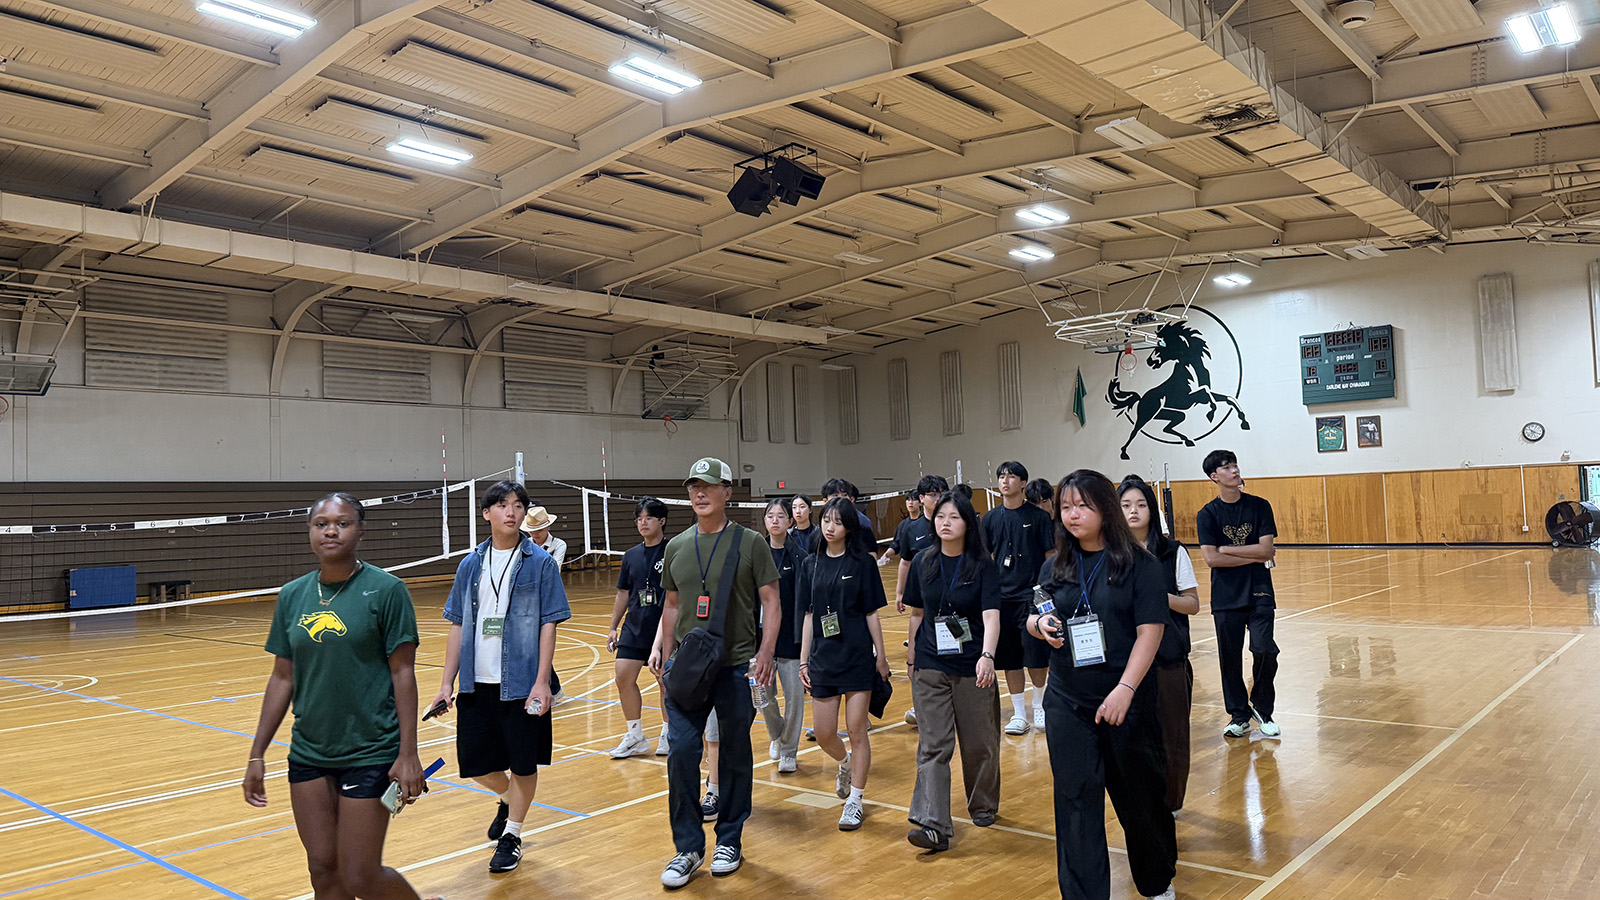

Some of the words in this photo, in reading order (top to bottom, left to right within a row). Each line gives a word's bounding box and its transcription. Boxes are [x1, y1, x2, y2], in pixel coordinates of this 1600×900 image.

[1336, 353, 1354, 362] period
[50, 525, 57, 533] 5
[80, 524, 87, 532] 5
[110, 523, 117, 531] 5
[240, 514, 245, 522] 7
